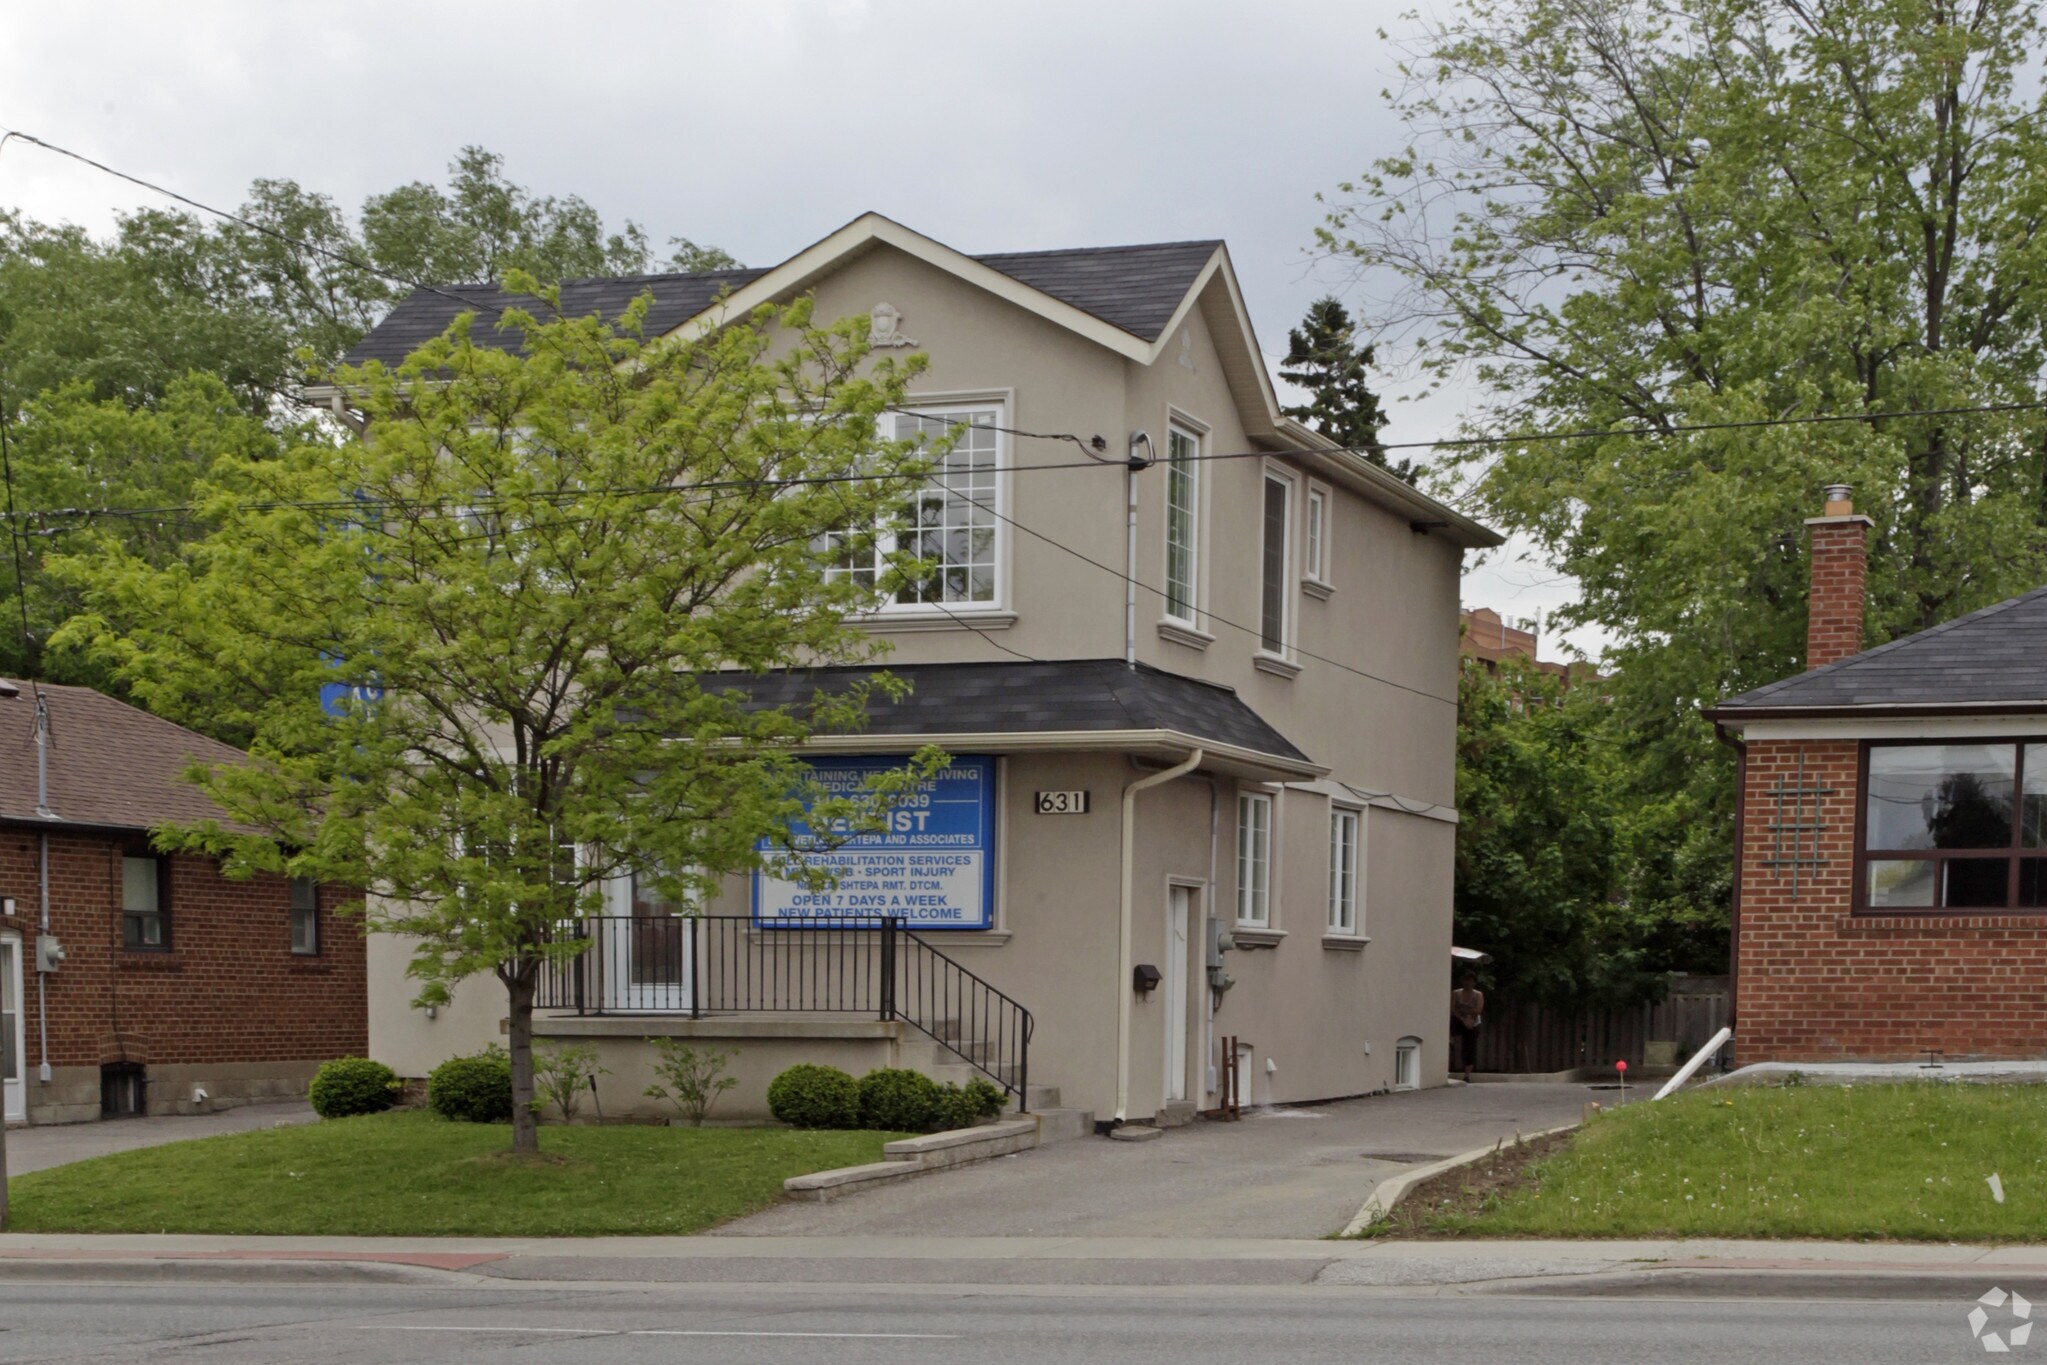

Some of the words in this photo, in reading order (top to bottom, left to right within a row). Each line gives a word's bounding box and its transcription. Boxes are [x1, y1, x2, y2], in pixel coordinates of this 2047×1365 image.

[813, 781, 874, 792] EDICA
[1040, 792, 1079, 811] 631
[885, 834, 907, 844] AND
[909, 834, 975, 845] ASSOCIATES
[804, 856, 904, 866] REHABILITATION
[908, 855, 971, 866] SERVICES
[865, 867, 906, 877] SPORT
[910, 867, 956, 877] INJURY
[840, 881, 879, 890] SHTEPA
[882, 881, 907, 890] RMT.
[909, 881, 943, 890] DTCM.
[792, 895, 831, 906] OPEN
[836, 895, 844, 906] 7
[849, 895, 886, 906] DAYS
[890, 895, 901, 906] A
[905, 895, 947, 906] WEEK
[778, 908, 811, 917] NEW
[815, 908, 882, 917] PATIENTS
[887, 908, 962, 919] WELCOME
